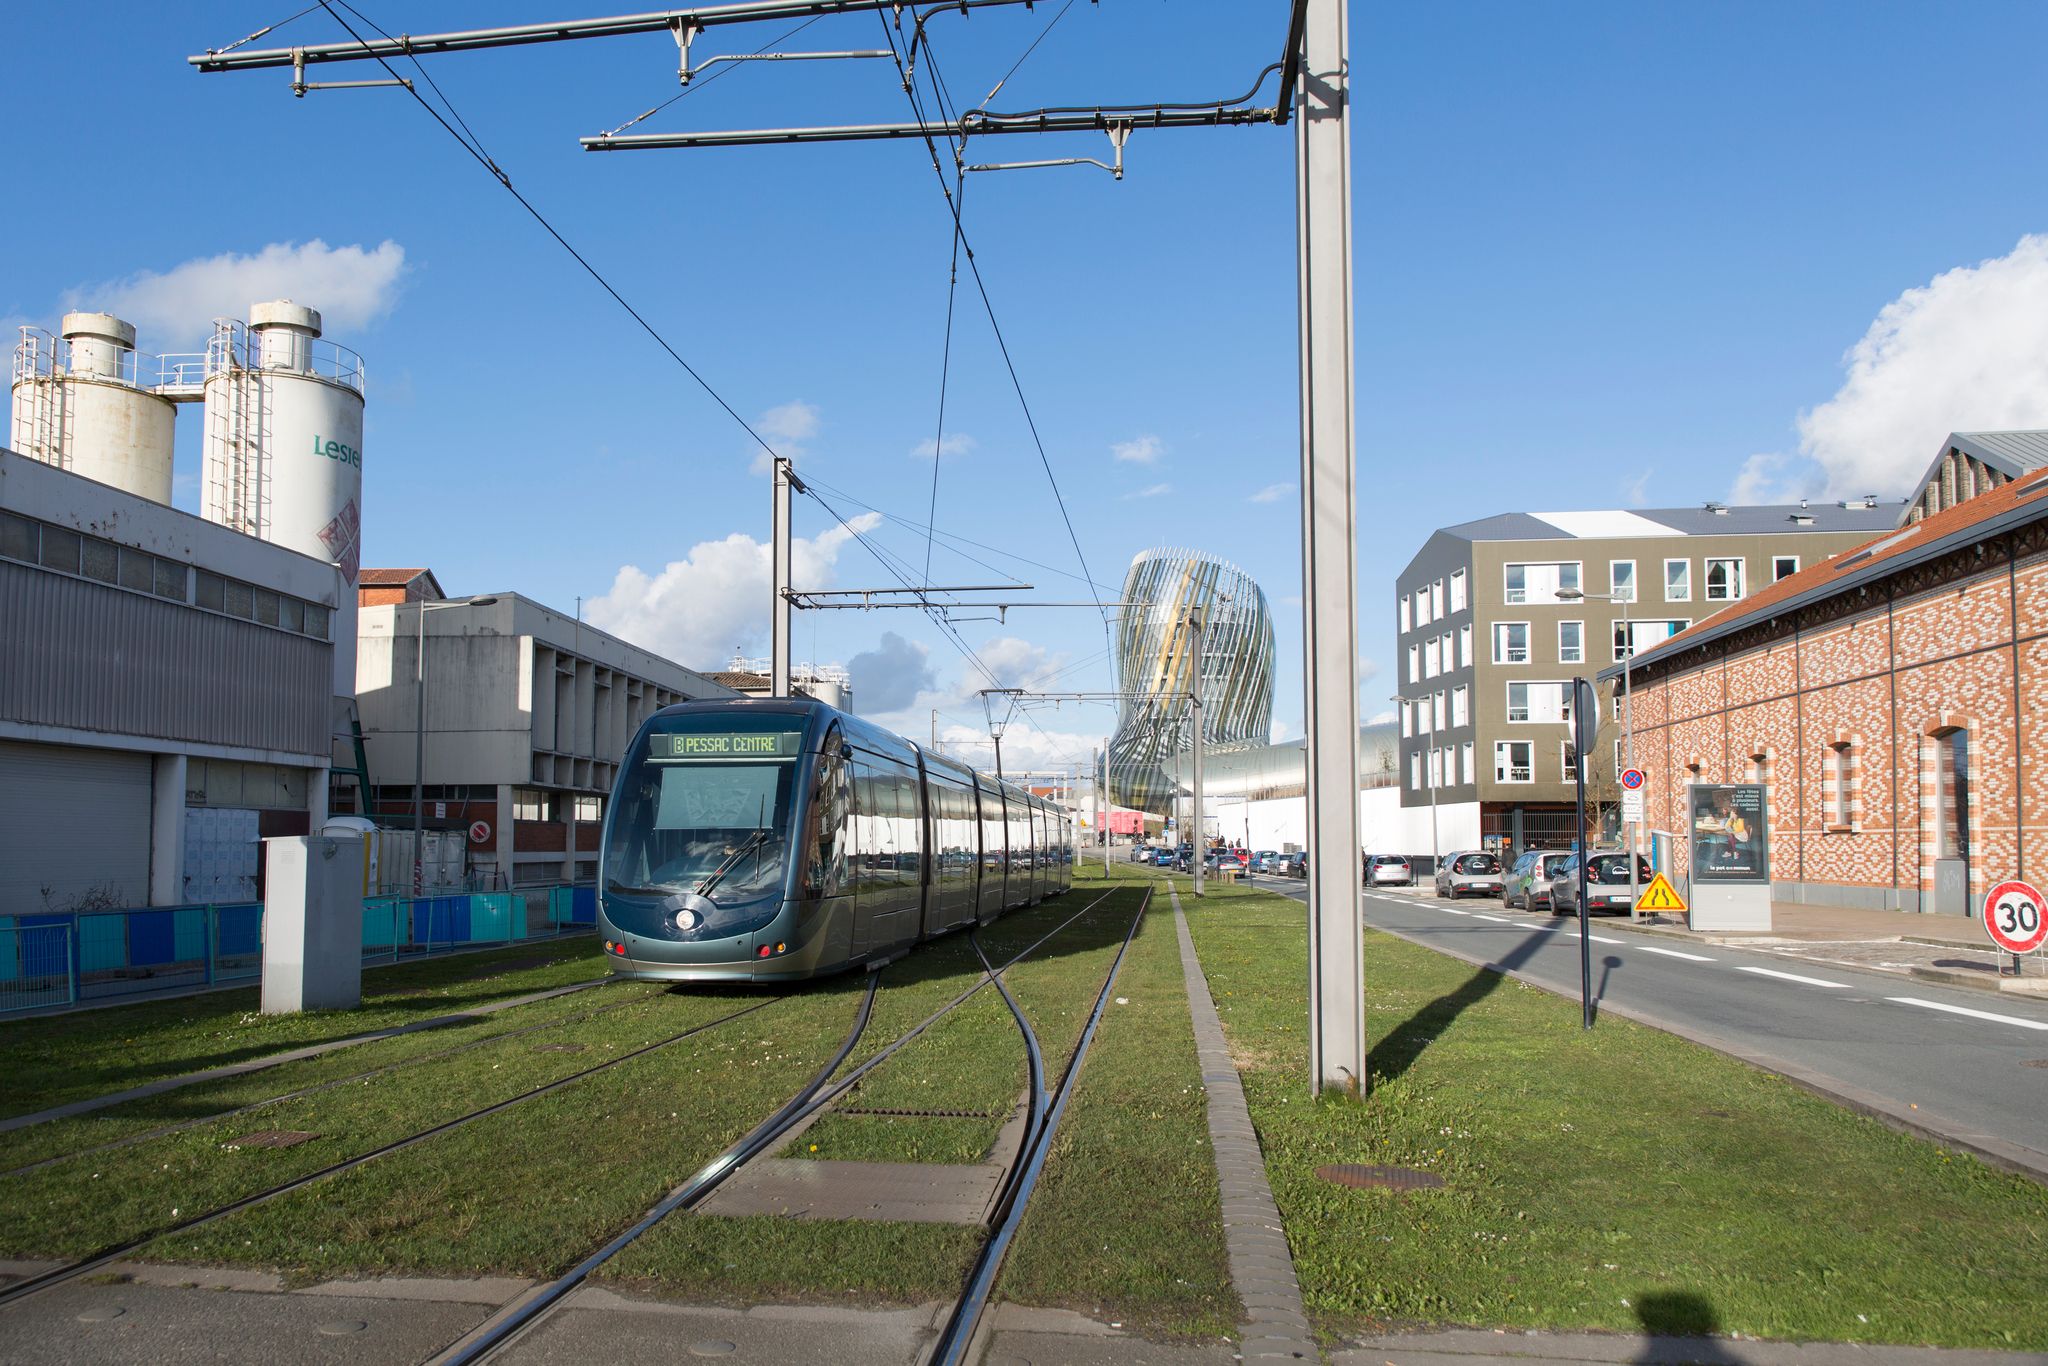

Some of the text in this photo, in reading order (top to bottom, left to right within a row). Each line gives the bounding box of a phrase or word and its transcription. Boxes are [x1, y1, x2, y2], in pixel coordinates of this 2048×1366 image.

[674, 736, 775, 753] B PESSAC CENTRE
[1998, 902, 2038, 933] 30
